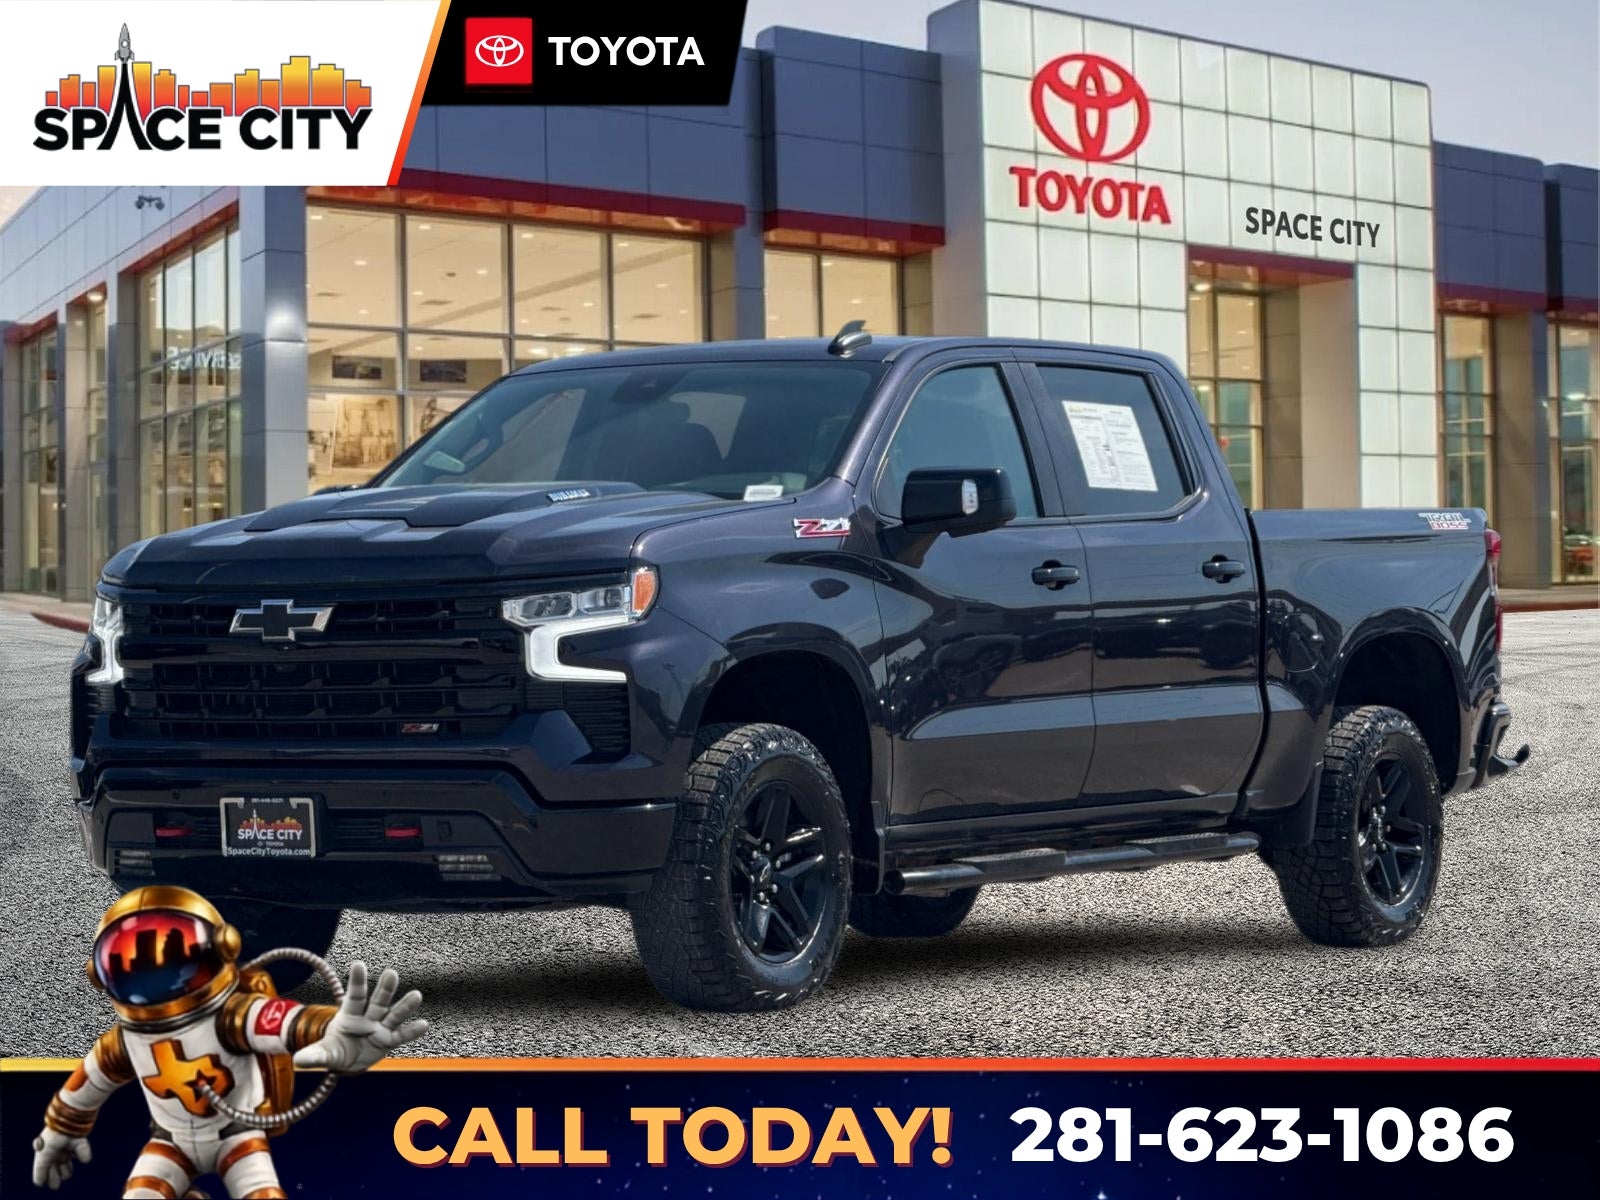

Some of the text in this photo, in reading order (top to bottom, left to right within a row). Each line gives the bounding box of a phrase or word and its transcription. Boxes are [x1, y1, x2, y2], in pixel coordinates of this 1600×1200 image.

[1009, 165, 1172, 225] TOYOTA
[1244, 205, 1382, 249] SPACE CITY
[238, 828, 303, 841] SPACE CITY
[227, 846, 312, 857] SpaceCityToyota.com
